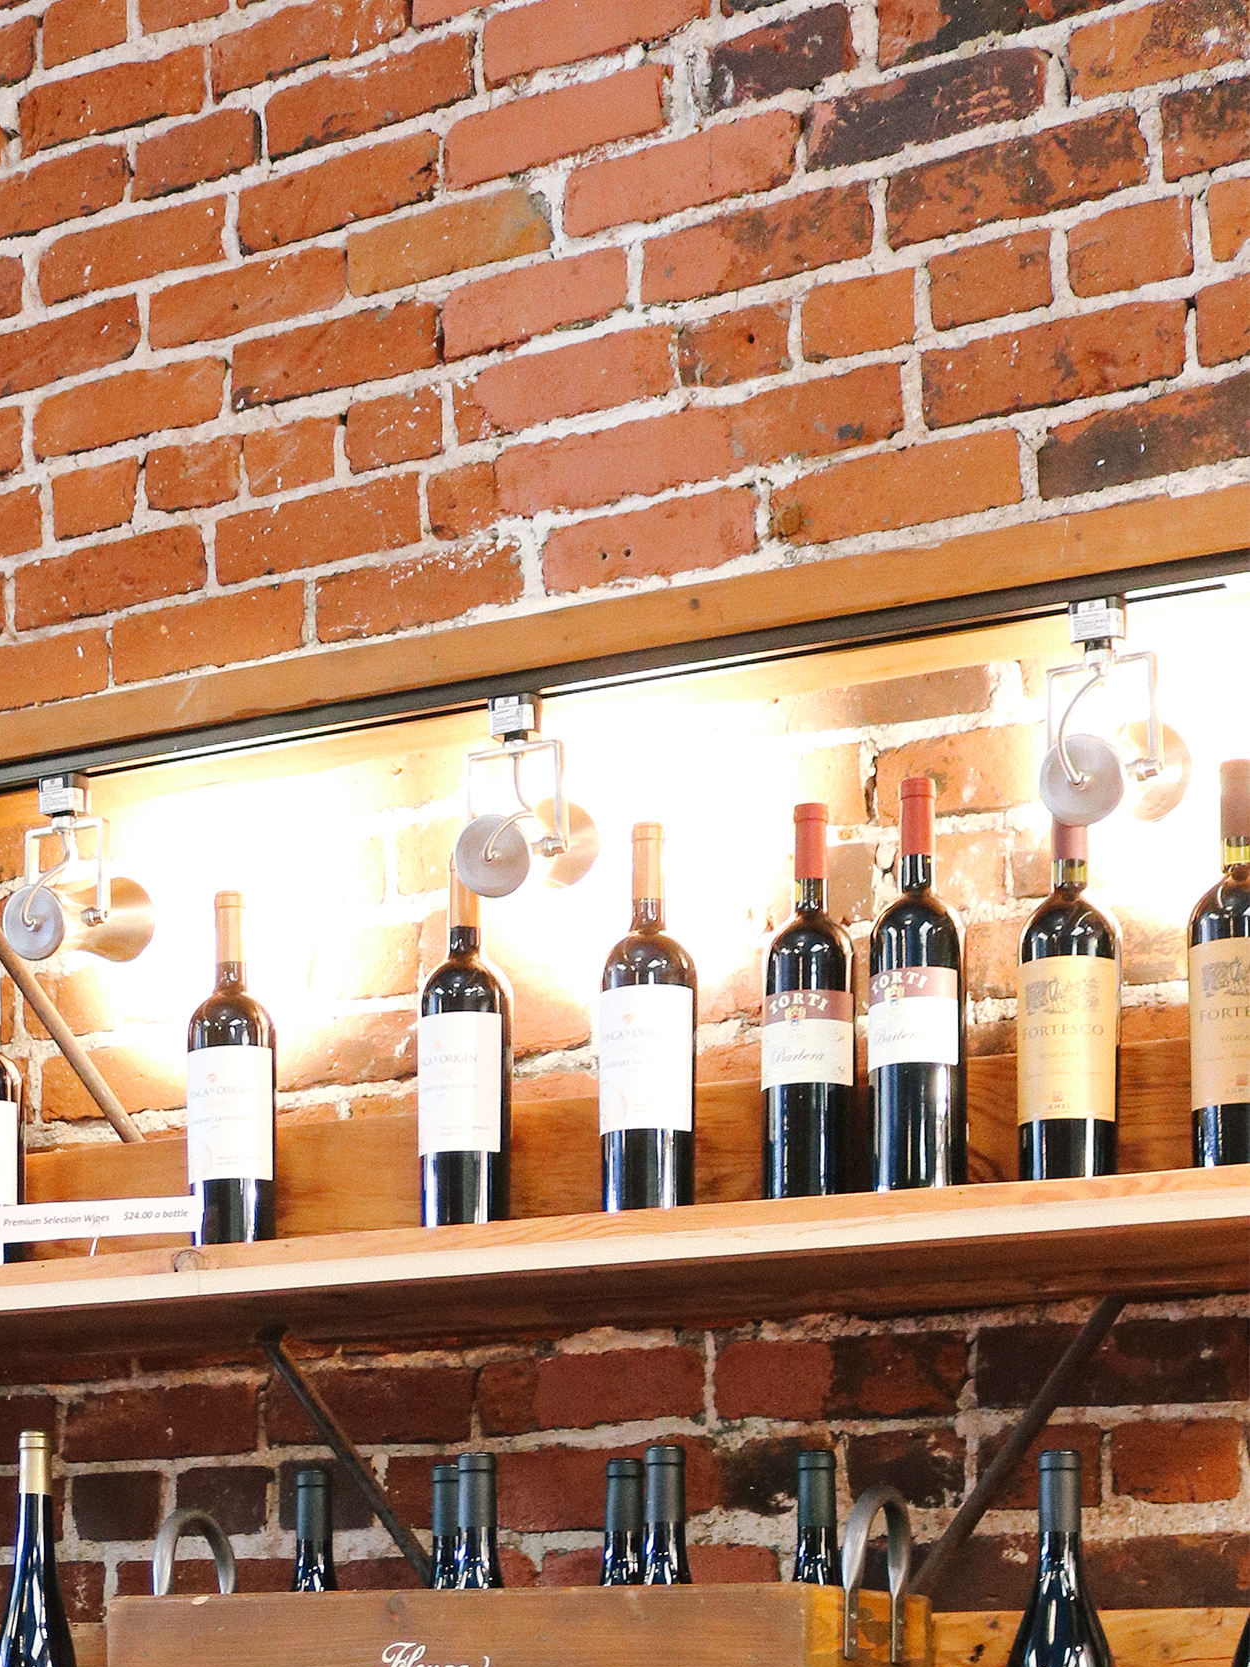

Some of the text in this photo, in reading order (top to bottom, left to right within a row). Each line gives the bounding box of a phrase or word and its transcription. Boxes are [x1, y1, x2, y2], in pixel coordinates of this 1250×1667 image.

[871, 970, 928, 994] TORTI
[769, 993, 829, 1015] TORTI
[1022, 1023, 1104, 1040] FORTESCO
[439, 1053, 478, 1064] ORIGEN
[772, 1047, 824, 1064] Barbera
[216, 1085, 253, 1096] ORIGEN
[3, 1217, 41, 1227] Premium
[43, 1213, 82, 1225] Selection
[123, 1210, 153, 1221] $24.00
[162, 1209, 188, 1219] bottle
